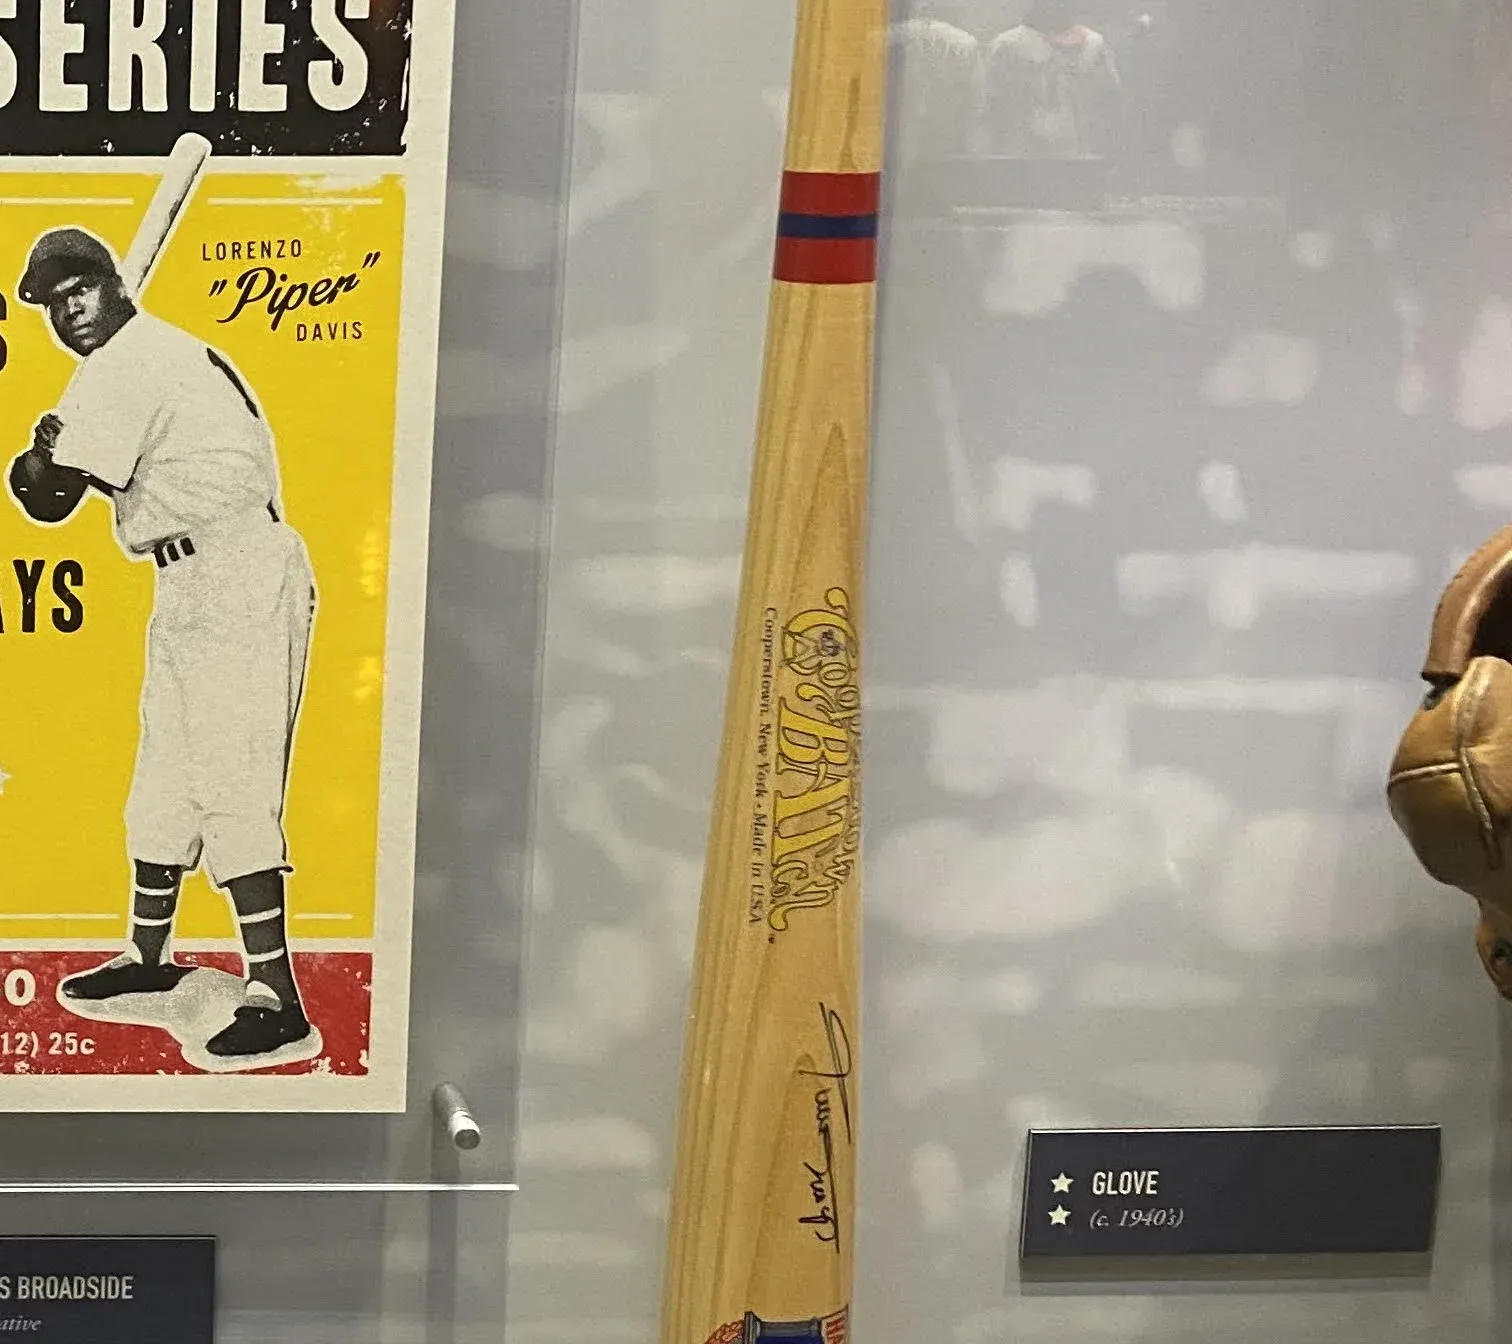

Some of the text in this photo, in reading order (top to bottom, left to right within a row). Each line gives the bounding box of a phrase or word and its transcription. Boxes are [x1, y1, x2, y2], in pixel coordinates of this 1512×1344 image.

[201, 240, 303, 261] LORENZO
[296, 320, 364, 341] DAVIS
[757, 723, 772, 756] New
[753, 762, 768, 798] York
[752, 812, 767, 857] Made
[0, 1030, 39, 1058] 12)
[48, 1032, 94, 1055] 25c
[1092, 1171, 1158, 1196] GLOVE
[1089, 1207, 1184, 1229] (c. 1940's)
[17, 1276, 134, 1300] BROADSIDE
